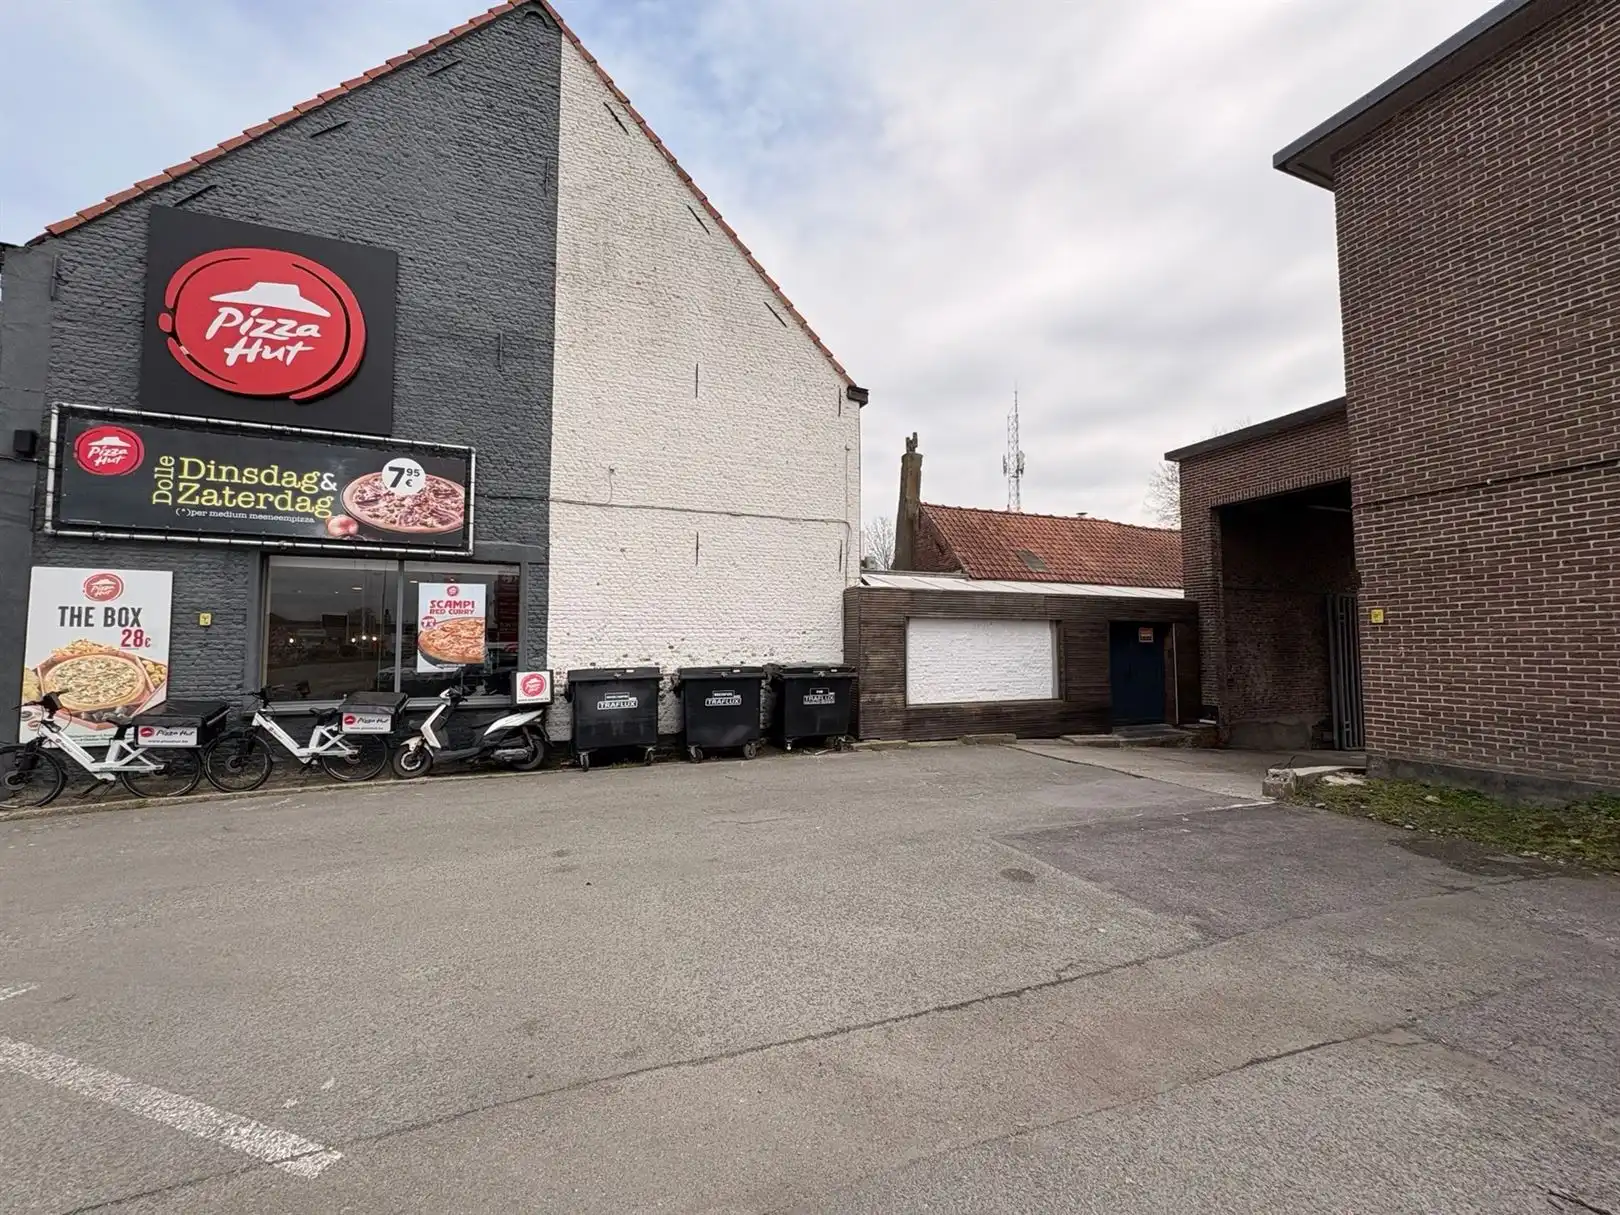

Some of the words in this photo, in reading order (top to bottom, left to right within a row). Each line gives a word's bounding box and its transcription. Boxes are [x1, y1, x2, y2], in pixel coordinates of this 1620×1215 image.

[205, 306, 322, 340] Pizza
[223, 336, 316, 367] Hut
[87, 445, 129, 459] Pizza
[93, 455, 127, 467] Hut
[152, 455, 176, 506] Dolle
[177, 481, 335, 519] Zaterdag
[209, 510, 248, 520] medium
[429, 600, 475, 609] SCAMPI
[58, 606, 96, 628] THE
[103, 606, 143, 628] BOX
[599, 700, 637, 709] TRAFLUX
